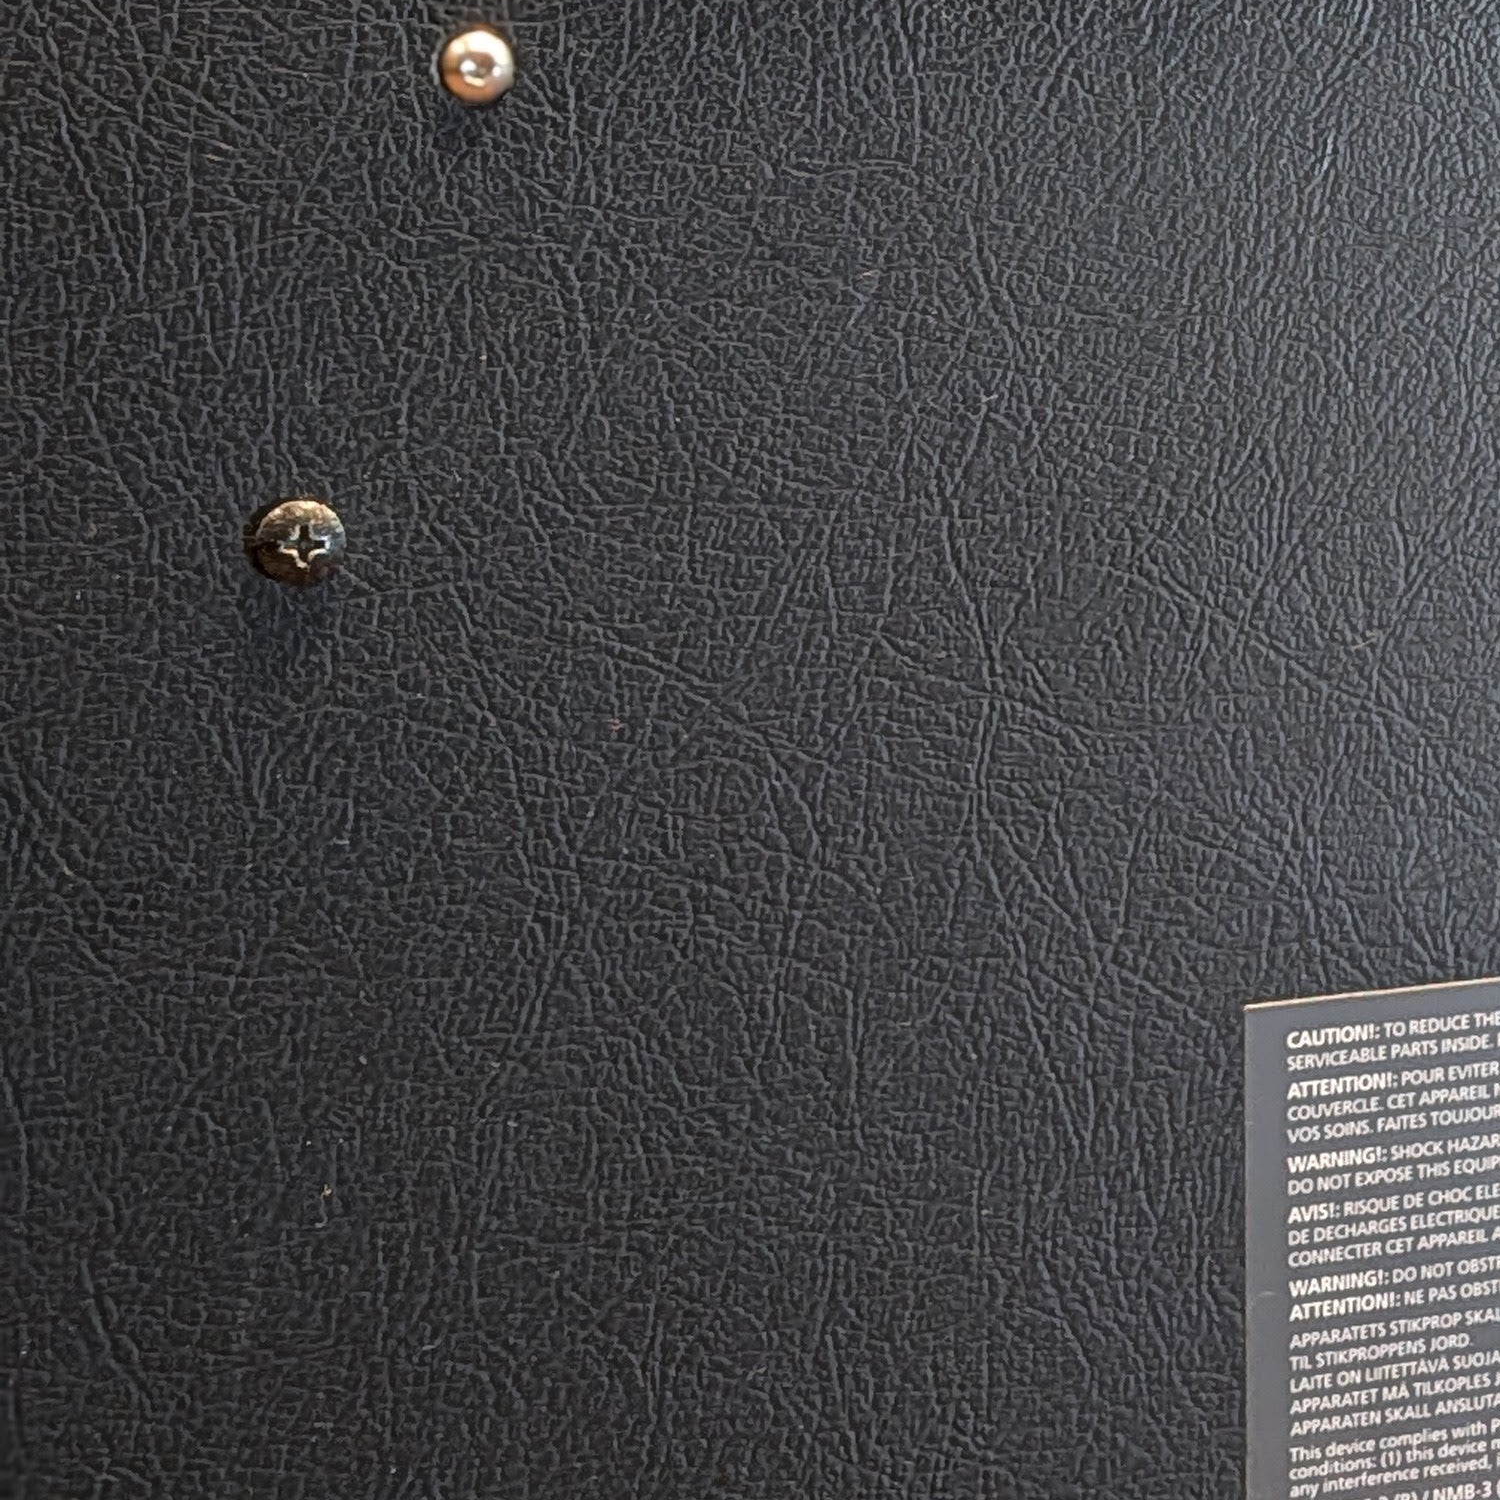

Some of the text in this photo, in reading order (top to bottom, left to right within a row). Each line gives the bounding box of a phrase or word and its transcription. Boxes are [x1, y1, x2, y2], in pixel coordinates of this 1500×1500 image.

[1286, 1022, 1380, 1049] CAUTION!:
[1384, 1019, 1405, 1038] TO
[1409, 1013, 1469, 1036] REDUCE
[1474, 1009, 1500, 1029] THE
[1286, 1043, 1386, 1070] SERVICEABLE
[1390, 1038, 1437, 1058] PARTS
[1287, 1070, 1398, 1099] ATTENTION!:
[1402, 1065, 1444, 1086] POUR
[1448, 1059, 1498, 1081] EVITER
[1387, 1090, 1415, 1109] CET
[1418, 1082, 1490, 1106] APPAREIL
[1288, 1240, 1382, 1267] CONNECTER
[1385, 1236, 1413, 1255] CET
[1417, 1227, 1487, 1251] APPAREIL
[1288, 1268, 1388, 1297] WARNING!:
[1392, 1264, 1416, 1283] DO
[1420, 1260, 1454, 1280] NOT
[1289, 1290, 1400, 1321] ATTENTION!:
[1404, 1287, 1424, 1306] NE
[1428, 1283, 1456, 1303] PAS
[1289, 1386, 1377, 1415] APPARATET
[1412, 1371, 1490, 1398] TILKOPLES
[1289, 1408, 1381, 1437] APPARATEN
[1385, 1401, 1430, 1423] SKALL
